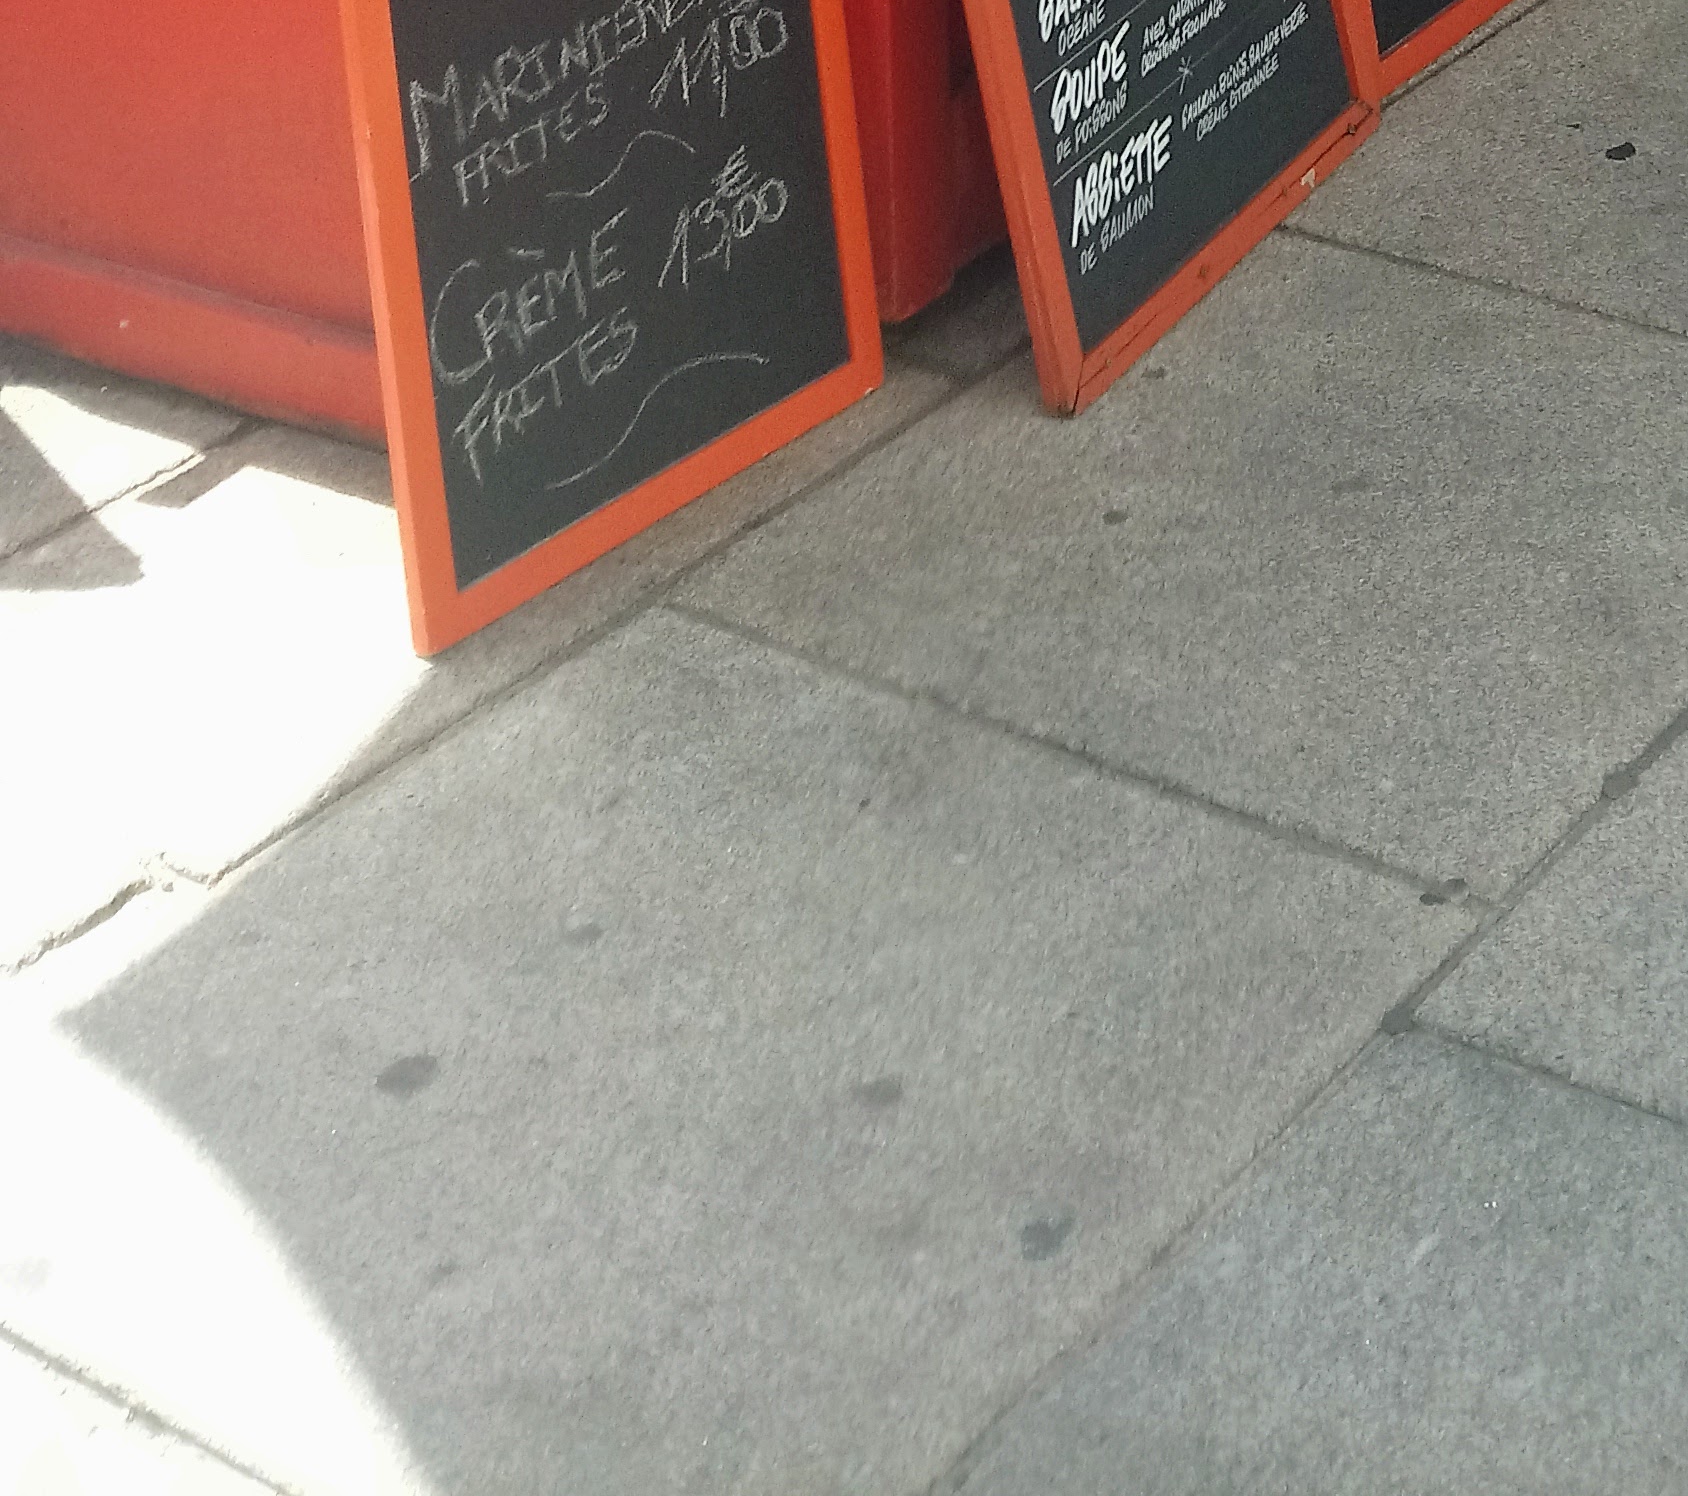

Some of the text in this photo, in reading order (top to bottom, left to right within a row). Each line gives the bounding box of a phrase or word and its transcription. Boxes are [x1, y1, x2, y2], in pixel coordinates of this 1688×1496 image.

[1050, 19, 1131, 136] SOUPE
[1142, 15, 1166, 51] AVEC
[1248, 24, 1281, 67] SALADE
[1055, 79, 1128, 165] DE POISSONS
[1196, 52, 1280, 142] CRÈME CITRONNÉE
[451, 82, 610, 208] FRITES
[1071, 114, 1173, 249] ASSIETTE
[1079, 184, 1155, 276] DE SAUMON
[452, 306, 640, 487] FRITES
